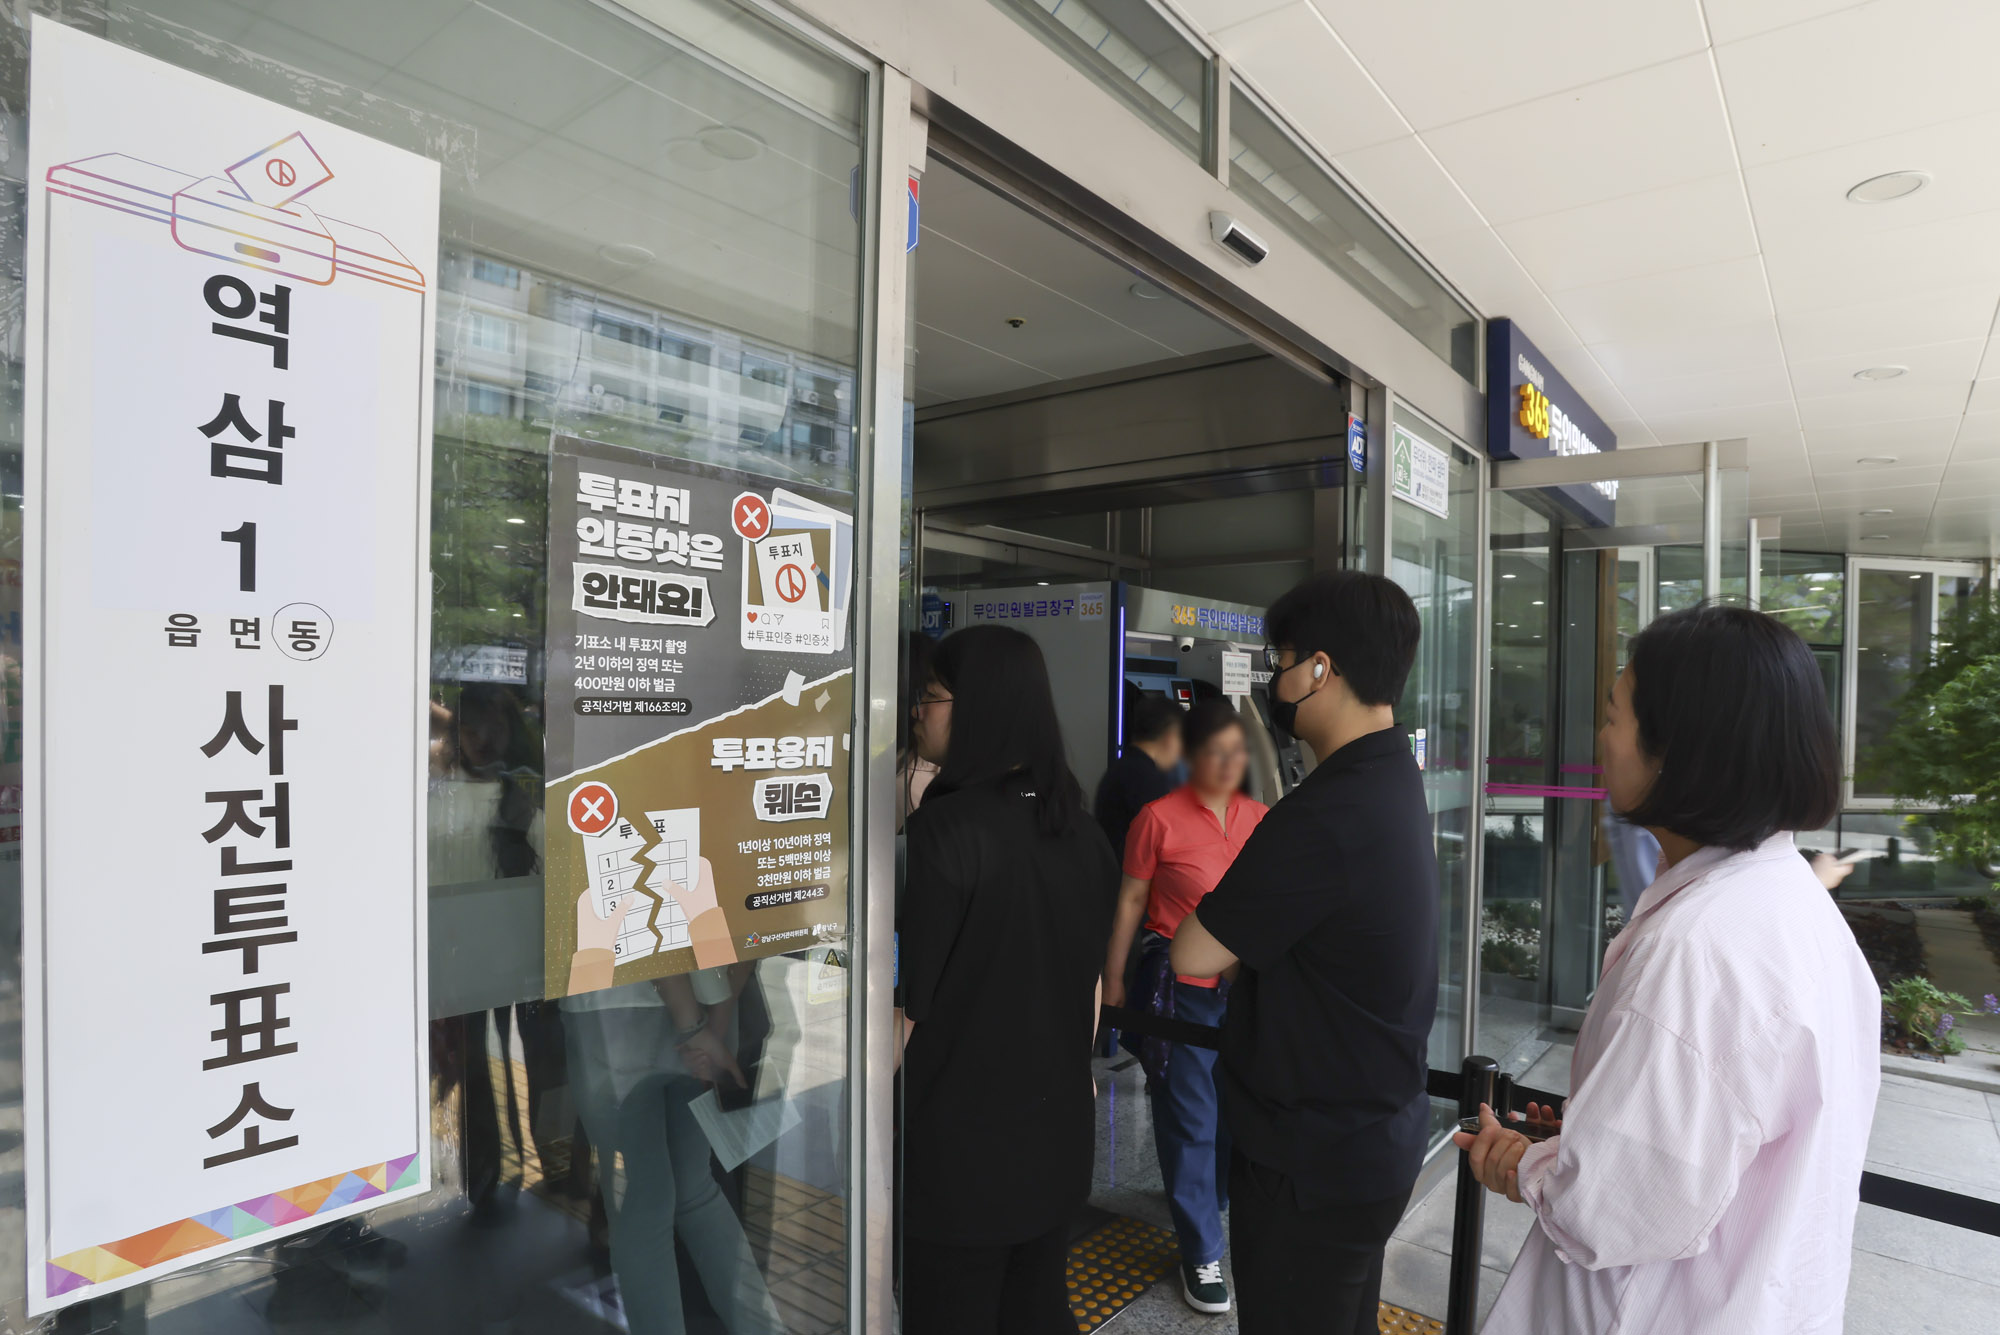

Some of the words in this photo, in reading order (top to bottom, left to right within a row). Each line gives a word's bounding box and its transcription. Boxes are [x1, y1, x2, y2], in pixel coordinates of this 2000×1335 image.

[1521, 383, 1549, 438] 365
[197, 274, 295, 592] 역삼1
[576, 472, 690, 525] 투표지
[576, 517, 724, 571] 인증샷은
[769, 542, 803, 560] 투표지
[582, 572, 703, 618] 안돼요!
[973, 599, 1075, 620] 무인민원발급창구
[1081, 602, 1103, 616] 365
[1172, 604, 1196, 626] 365
[1197, 607, 1265, 637] 무인민원발급창
[164, 613, 201, 648] 읍
[230, 617, 261, 650] 면
[288, 620, 321, 653] 동
[747, 630, 792, 645] #투표인증
[795, 633, 829, 647] #인증샷
[575, 634, 612, 650] 기표소
[614, 636, 626, 652] 내
[628, 637, 663, 653] 투표지
[665, 639, 687, 655] 촬영
[575, 655, 595, 671] 2년
[598, 656, 633, 672] 이하의
[636, 657, 658, 673] 징역
[661, 659, 684, 674] 또는
[574, 676, 625, 691] 400만원
[627, 677, 651, 692] 이하
[653, 678, 676, 693] 벌금
[581, 700, 632, 713] 공직선거법
[634, 700, 687, 713] 제166조의2
[711, 735, 834, 772] 투표용지
[763, 782, 822, 816] 훼손
[737, 838, 771, 853] 1년이상
[774, 834, 812, 849] 10년이하
[813, 832, 831, 846] 징역
[606, 858, 611, 868] 1
[757, 856, 777, 869] 또는
[778, 851, 812, 867] 5백만원
[813, 849, 832, 863] 이상
[607, 879, 615, 891] 2
[757, 871, 792, 887] 3천만원
[794, 868, 812, 882] 이하
[813, 866, 831, 880] 벌금
[609, 901, 617, 912] 3
[752, 891, 792, 907] 공직선거법
[794, 887, 824, 900] 제244조
[200, 684, 299, 1170] 사전투표소
[614, 944, 622, 955] 5
